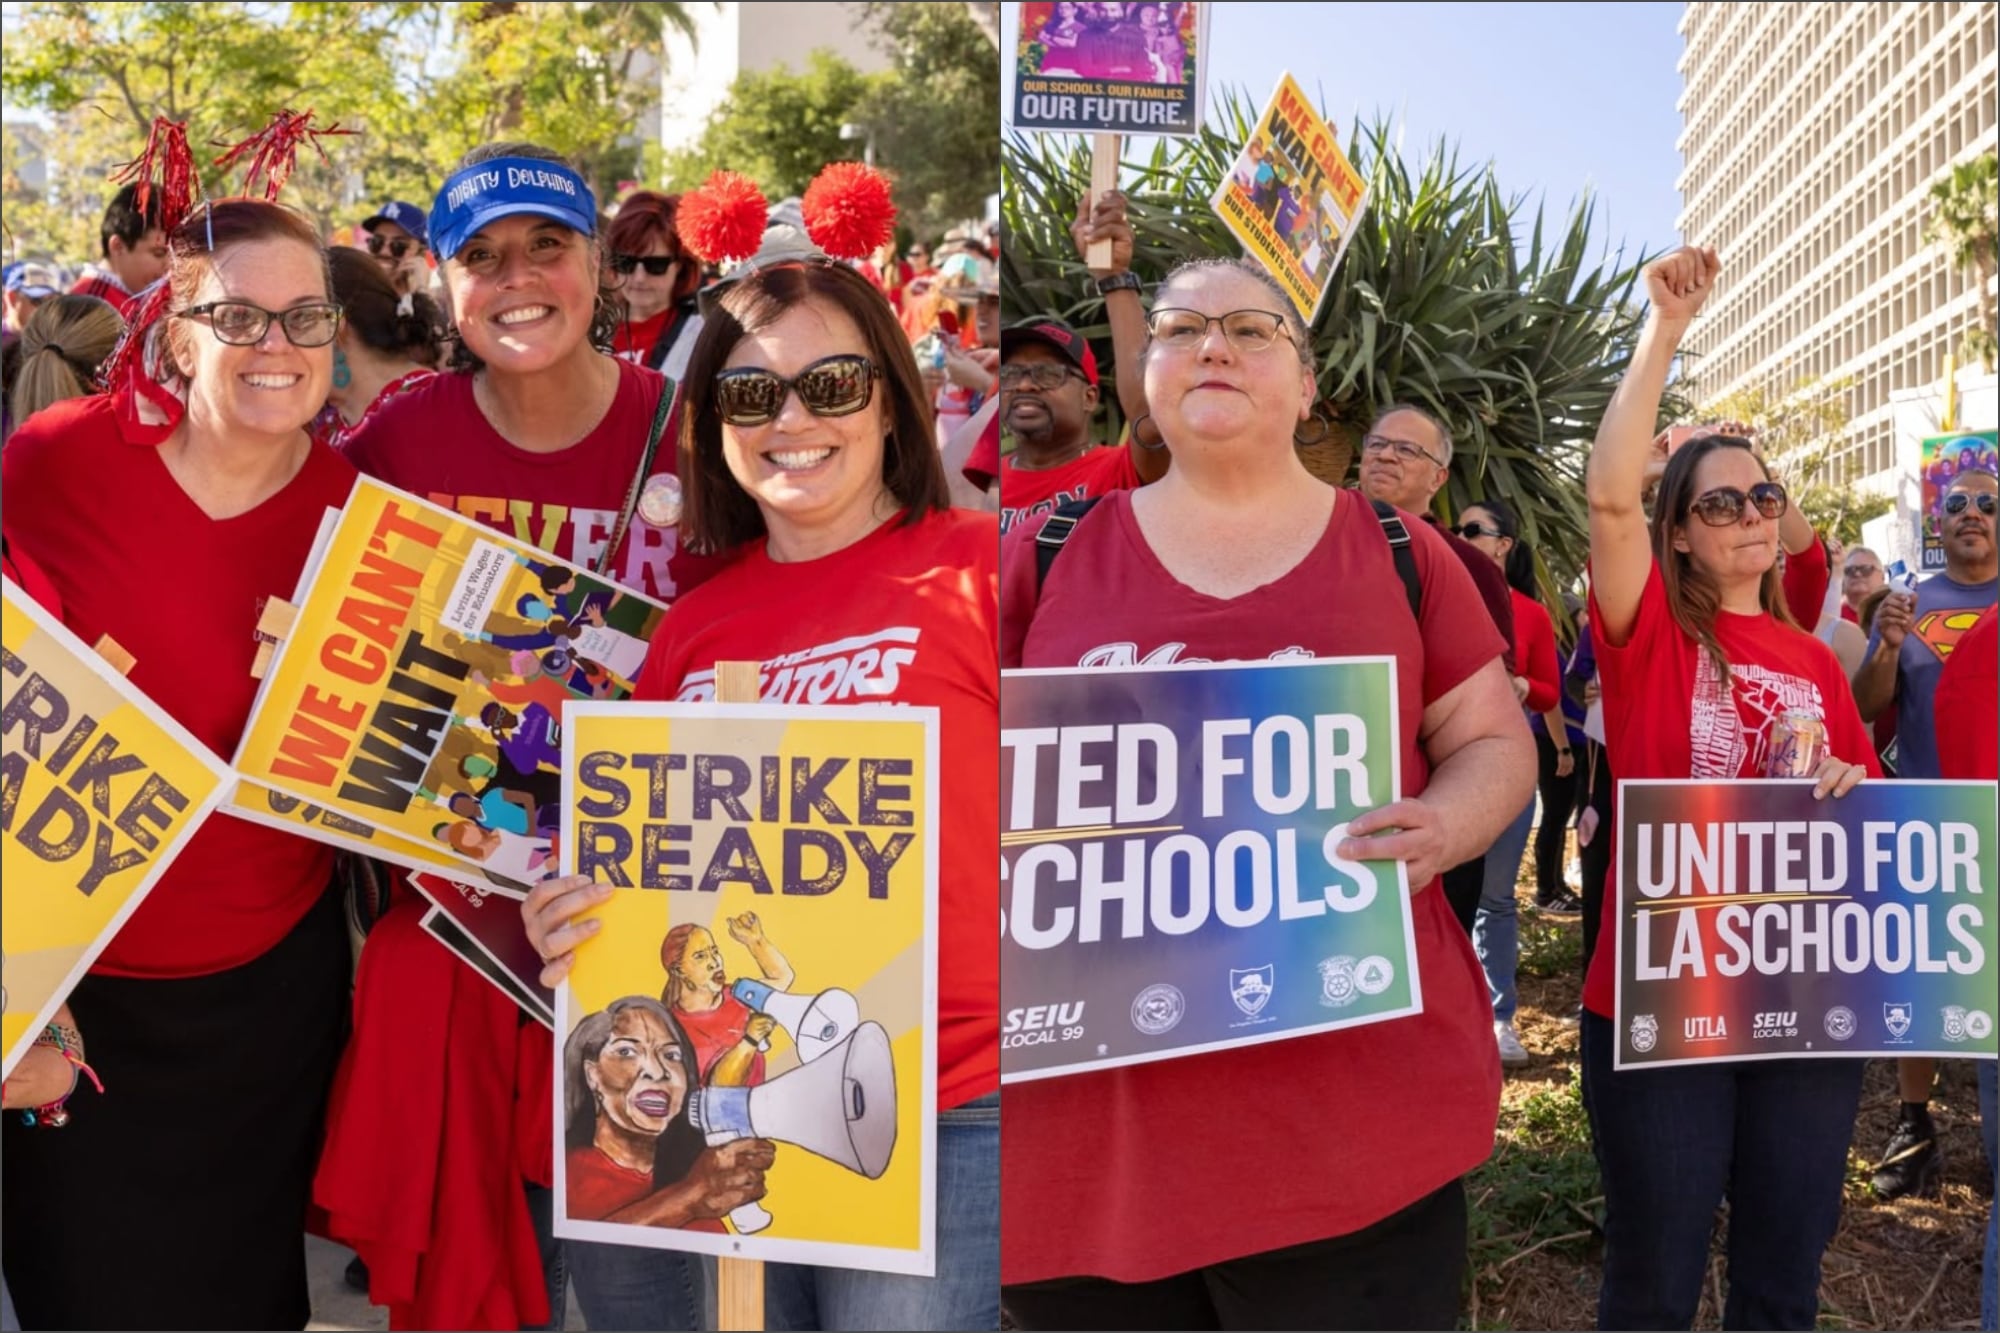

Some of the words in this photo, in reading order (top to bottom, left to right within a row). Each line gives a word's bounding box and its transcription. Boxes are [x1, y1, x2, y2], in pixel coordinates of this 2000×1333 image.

[1021, 94, 1076, 120] OUR
[1082, 97, 1188, 125] FUTURE.
[1023, 80, 1049, 93] OUR
[1050, 81, 1106, 95] SCHOOLS.
[1108, 85, 1132, 97] OUR
[1134, 86, 1188, 100] FAMILIES.
[1268, 106, 1325, 191] WAIT
[1279, 86, 1312, 139] WE
[1312, 133, 1360, 209] CAN'T
[447, 170, 500, 213] MIGHTY
[507, 167, 576, 196] DOLPHINS
[1231, 186, 1264, 224] INVEST
[1262, 222, 1273, 236] IN
[1225, 194, 1244, 218] OUR
[1243, 217, 1285, 270] STUDENTS
[1284, 269, 1315, 311] DESERVE
[452, 585, 475, 623] Living
[468, 548, 490, 584] Wages
[465, 611, 476, 630] for
[472, 553, 505, 612] Educators
[269, 685, 368, 787] WE
[320, 500, 444, 686] CAN'T
[337, 629, 470, 814] WAIT
[577, 750, 914, 827] STRIKE
[1203, 713, 1373, 818] FOR
[577, 821, 916, 900] READY
[1001, 822, 1378, 950] CHOOLS
[1637, 821, 1848, 898] UNITED
[1863, 820, 1983, 894] FOR
[1635, 907, 1707, 981] LA
[1715, 901, 1985, 978] SCHOOLS
[1002, 1029, 1057, 1049] LOCAL
[1061, 1026, 1084, 1041] 99
[1003, 1001, 1085, 1034] SEIU
[1684, 1015, 1728, 1039] UTLA
[1753, 1011, 1798, 1028] SEIU
[1753, 1028, 1783, 1039] LOCAL
[1785, 1027, 1798, 1038] 99
